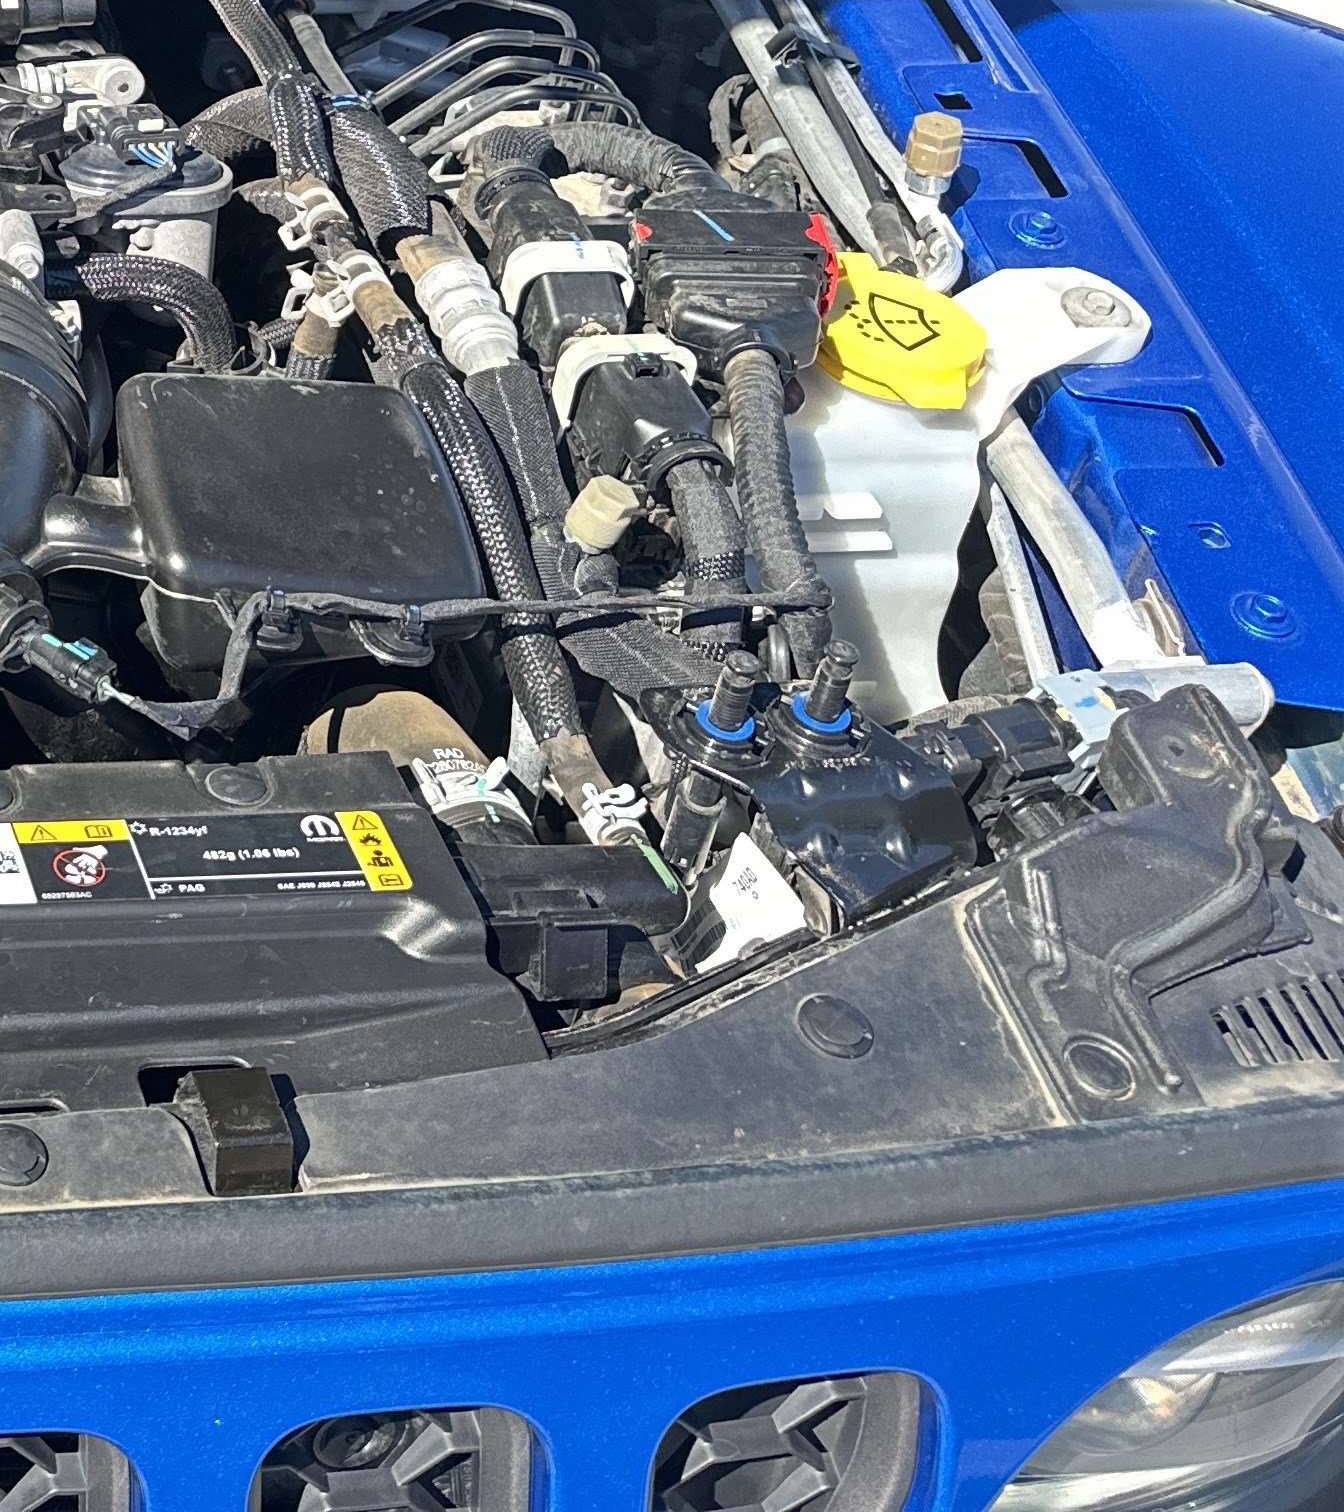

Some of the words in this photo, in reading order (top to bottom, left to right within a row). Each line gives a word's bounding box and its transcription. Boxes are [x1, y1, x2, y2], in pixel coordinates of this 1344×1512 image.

[433, 748, 464, 760] RAD
[150, 825, 208, 837] R-1234yf
[202, 850, 237, 862] 482g
[274, 847, 300, 859] lbs)
[178, 883, 206, 893] PAG
